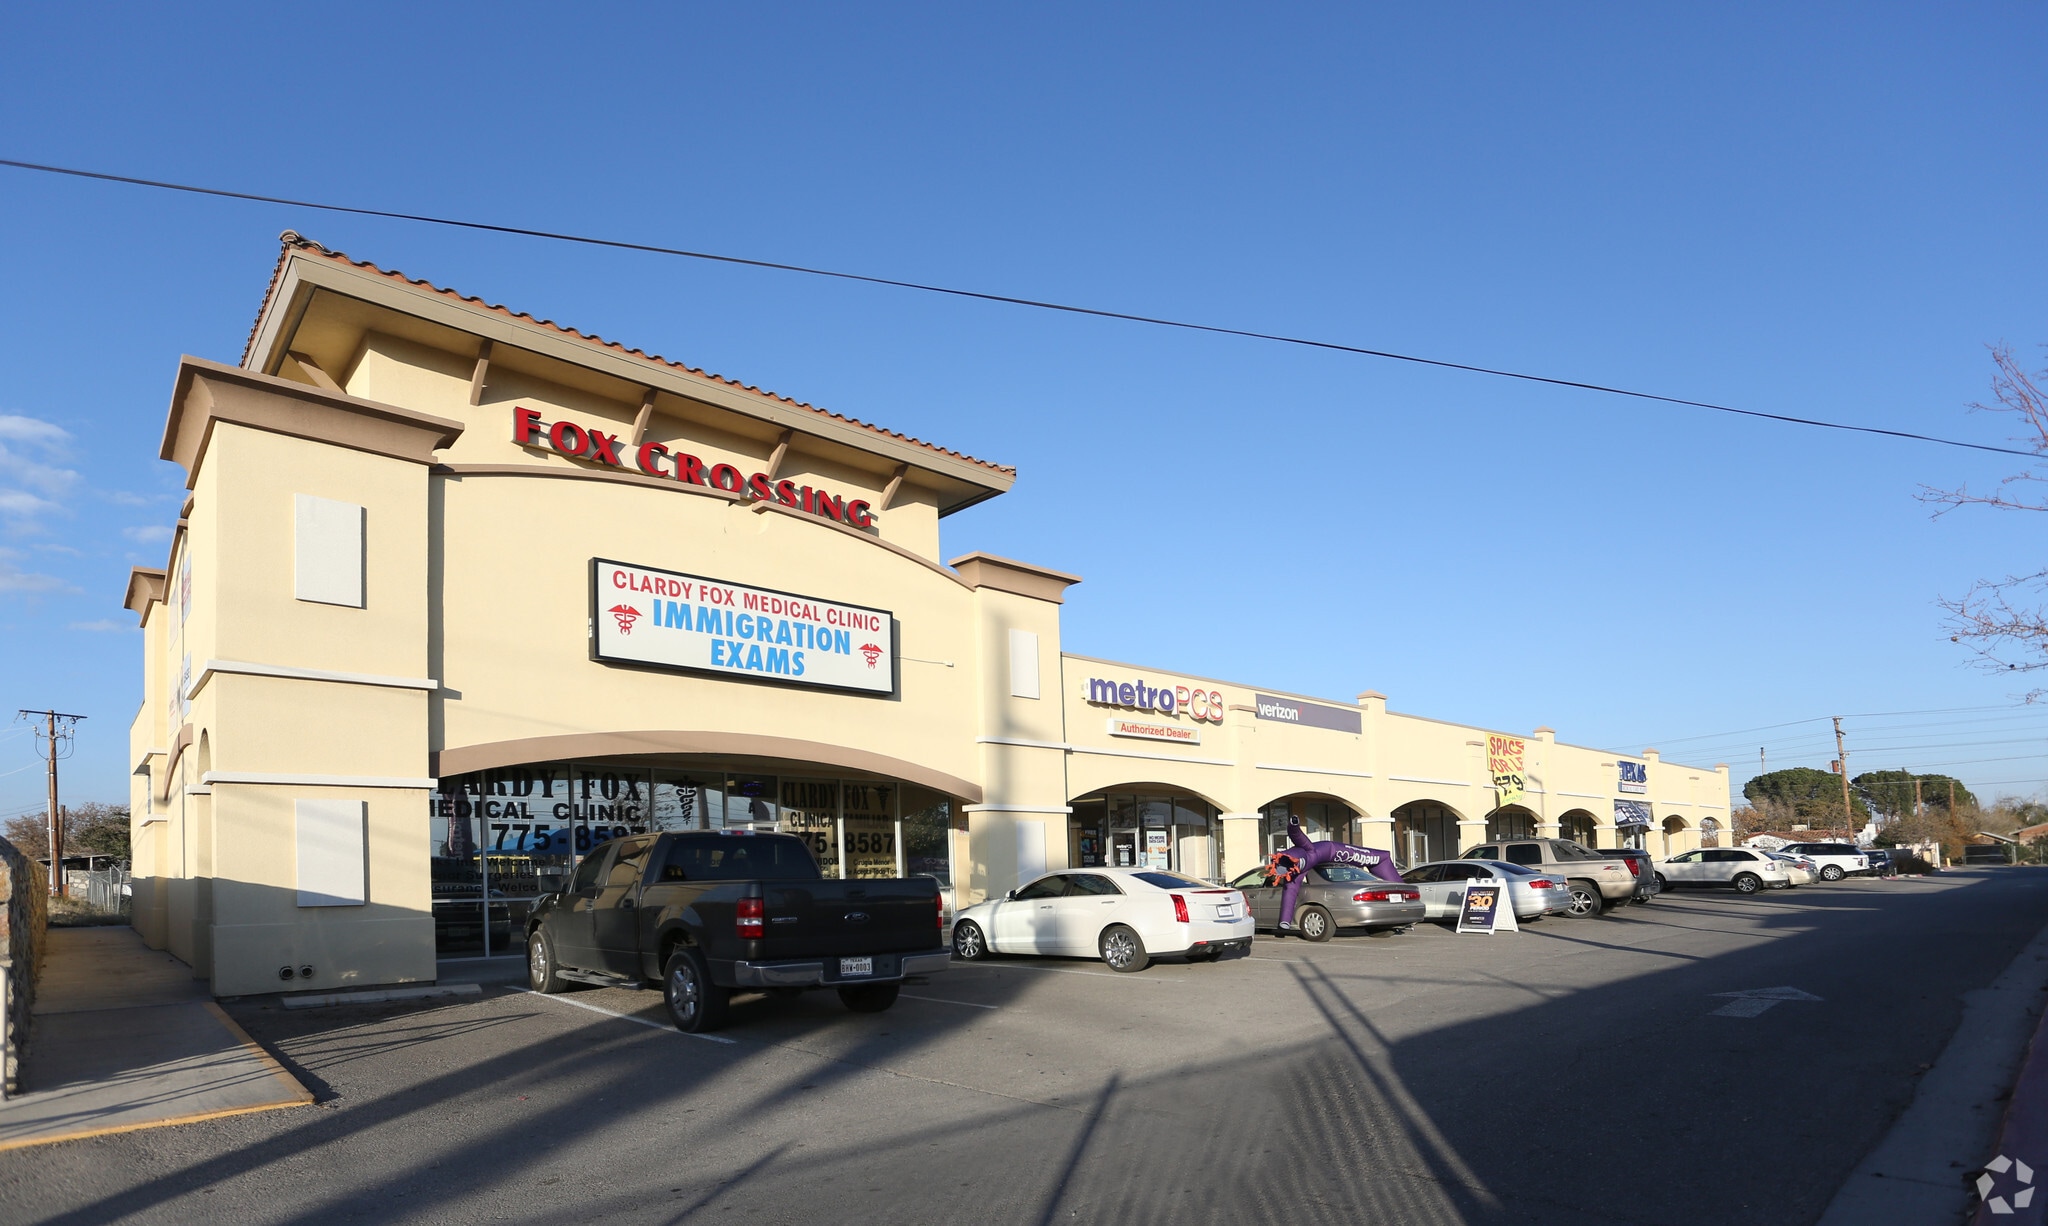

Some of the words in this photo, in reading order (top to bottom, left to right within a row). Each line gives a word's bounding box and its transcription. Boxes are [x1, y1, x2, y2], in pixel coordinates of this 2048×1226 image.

[513, 406, 620, 466] FOX
[637, 441, 872, 528] CROSSING
[612, 570, 693, 600] CLARDY
[699, 584, 735, 607] FOX
[743, 592, 821, 622] MEDICAL
[826, 608, 880, 632] CLINIC
[653, 598, 851, 656] IMMIGRATION
[711, 638, 805, 676] EXAMS
[1089, 677, 1224, 721] metroPCS
[1258, 702, 1299, 721] verizon
[1120, 723, 1165, 737] Authorized
[1166, 727, 1192, 740] Dealer
[436, 768, 556, 798] LARDY
[580, 771, 642, 801] FOX
[843, 785, 869, 810] FOX
[553, 803, 641, 822] CLINIC
[785, 831, 897, 854] 75-8587
[498, 883, 539, 893] Welco
